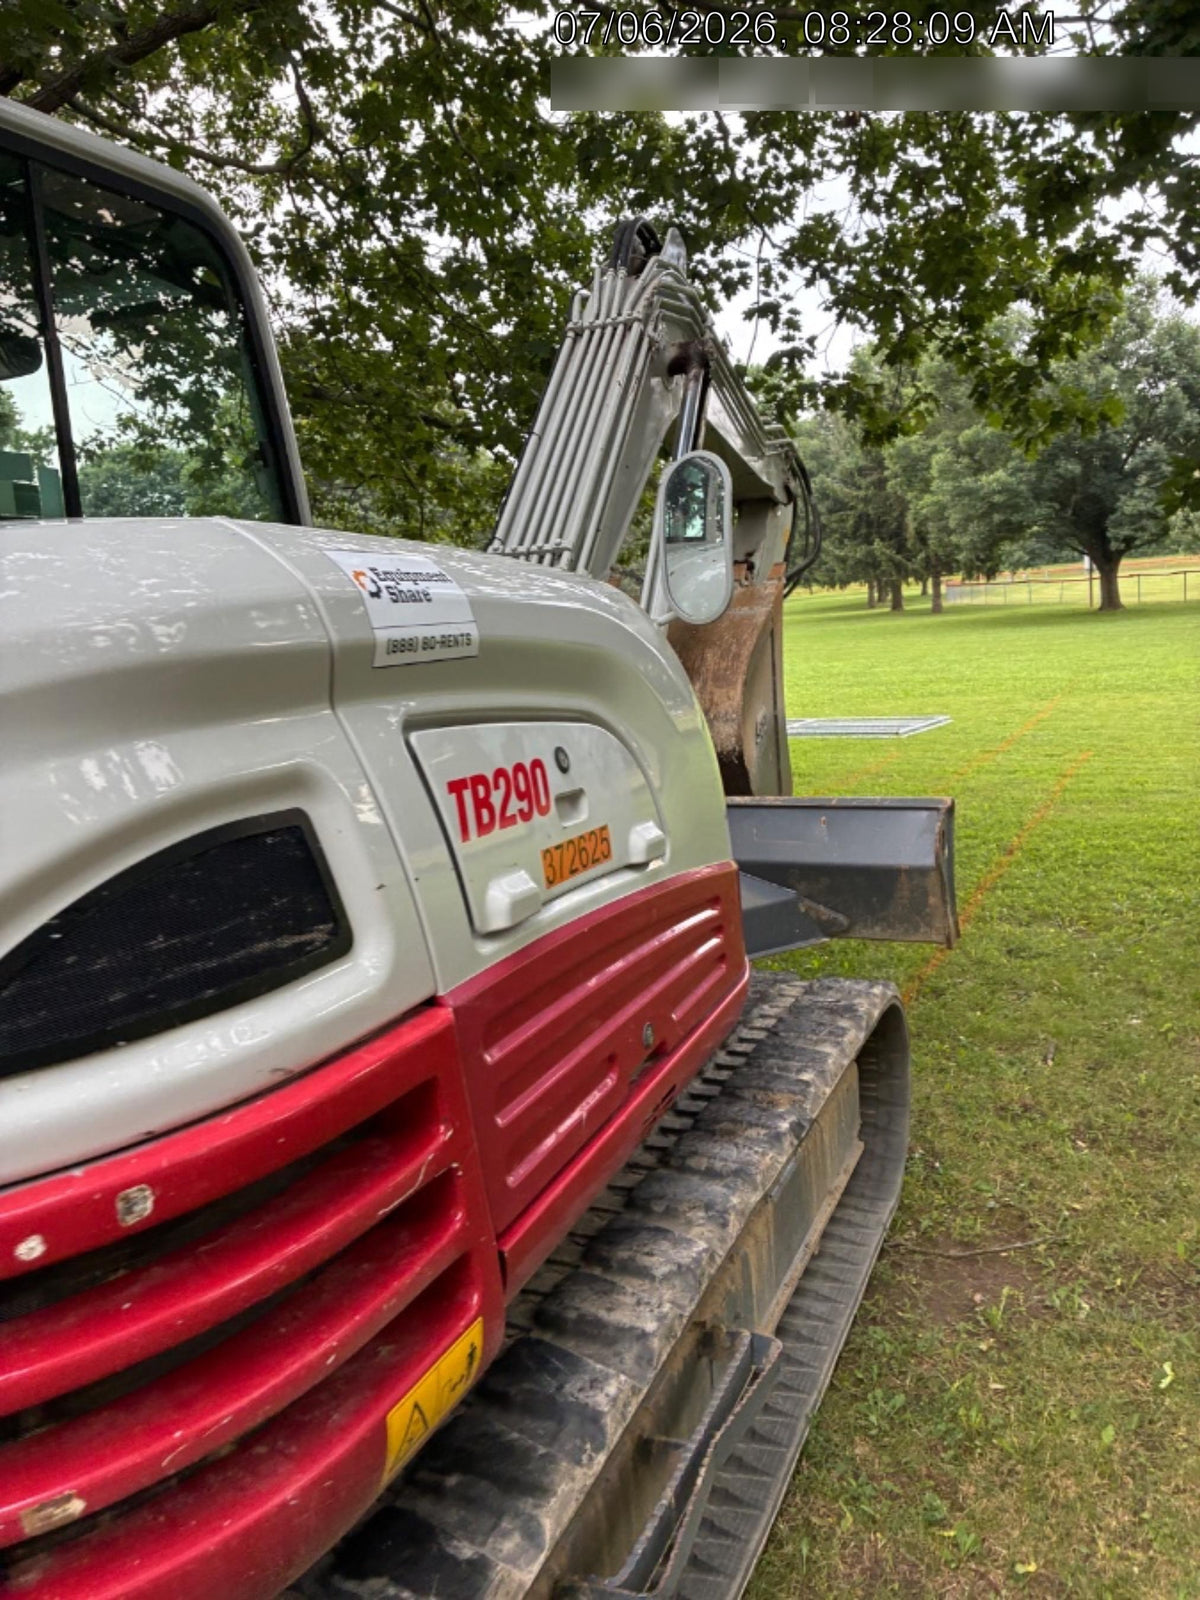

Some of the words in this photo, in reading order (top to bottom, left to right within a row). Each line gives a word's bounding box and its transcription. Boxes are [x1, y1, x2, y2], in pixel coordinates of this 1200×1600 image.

[368, 566, 453, 586] Equipment
[385, 585, 433, 603] Share
[386, 636, 419, 655] (888)
[446, 758, 551, 843] TB290
[543, 827, 612, 884] 372625
